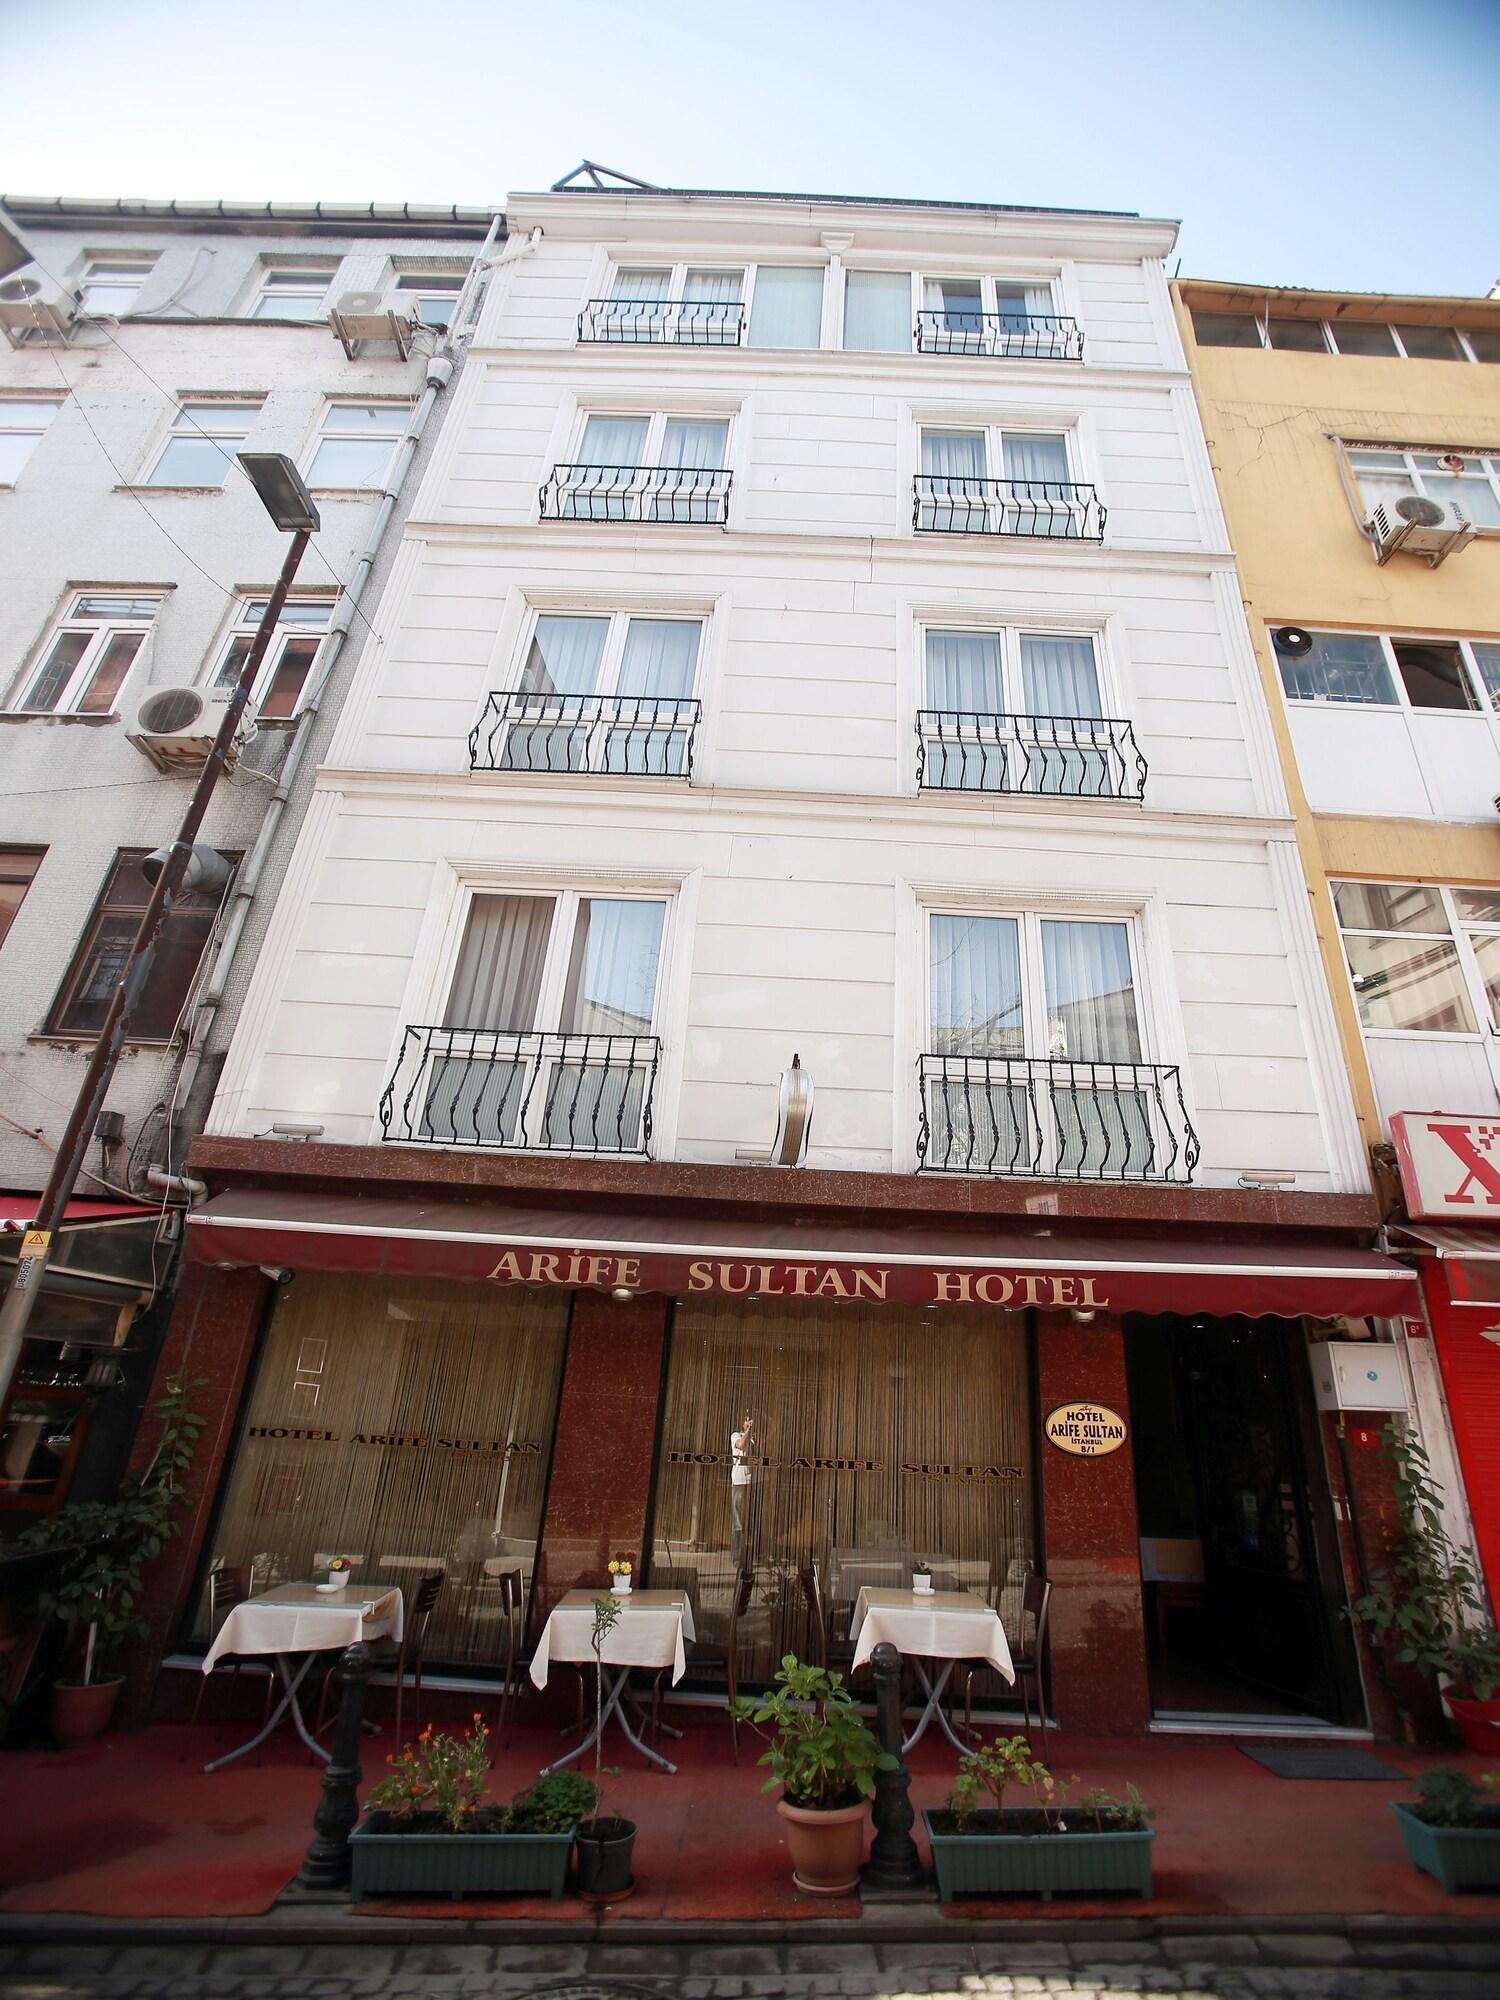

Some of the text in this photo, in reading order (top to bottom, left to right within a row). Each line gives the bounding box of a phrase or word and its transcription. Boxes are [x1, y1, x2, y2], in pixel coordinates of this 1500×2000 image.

[486, 1248, 1109, 1307] ARİFE SULTAN HOTEL
[1066, 1411, 1105, 1422] HOTEL
[1051, 1420, 1123, 1439] ARİFE SULTAN
[1361, 1432, 1368, 1442] 8
[248, 1427, 340, 1442] HOTEL
[436, 1438, 542, 1453] SULTAN
[1081, 1445, 1095, 1454] 8/1
[668, 1451, 1025, 1478] HOTEL ARİFE SULTAN
